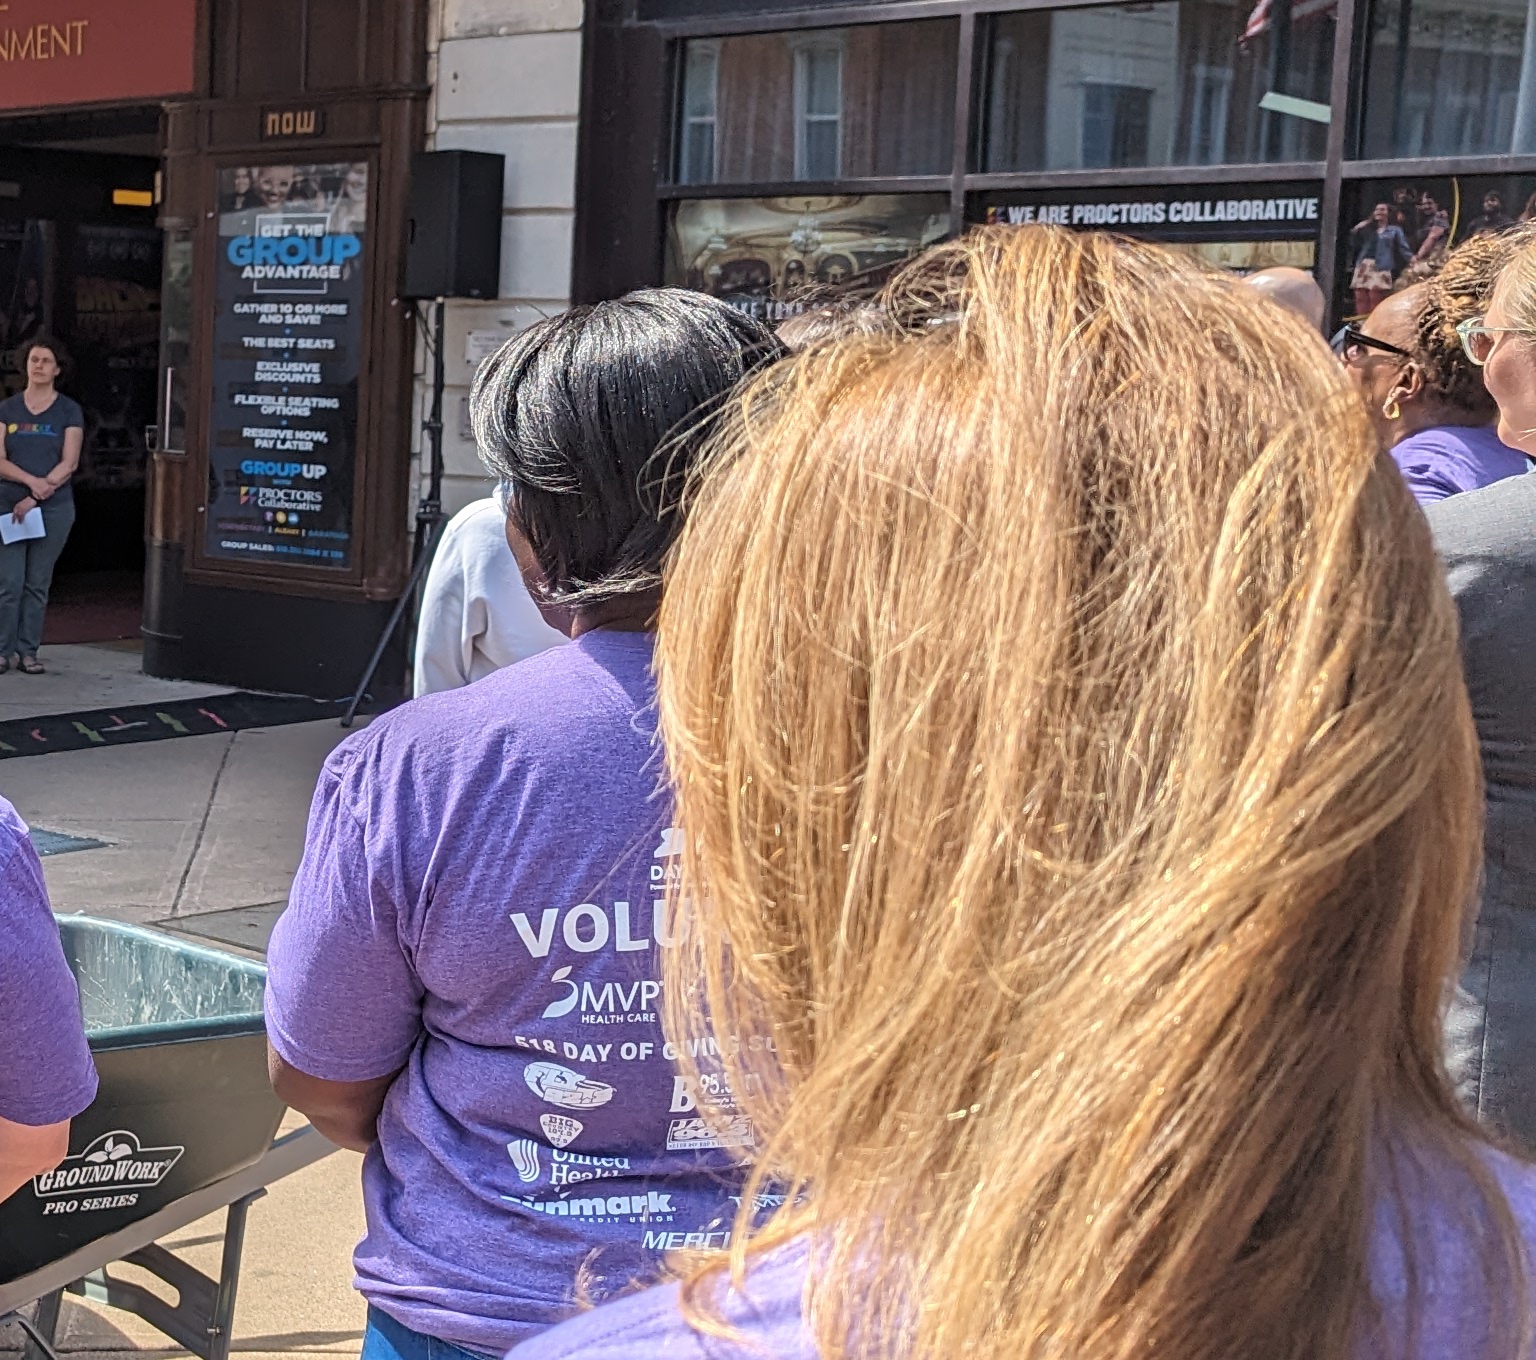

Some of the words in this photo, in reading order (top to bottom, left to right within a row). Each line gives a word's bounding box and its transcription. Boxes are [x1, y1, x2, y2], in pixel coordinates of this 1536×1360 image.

[1008, 206, 1034, 224] WE
[1037, 205, 1068, 223] ARE
[1074, 203, 1165, 225] PROCTORS
[1169, 198, 1317, 223] COLLABORATIVE
[261, 225, 291, 237] GET
[295, 224, 323, 237] THE
[227, 234, 360, 266] GROUP
[241, 265, 341, 280] ADVANTAGE
[233, 303, 278, 314] GATHER
[280, 303, 293, 314] 10
[295, 303, 313, 314] OR
[315, 303, 347, 315] MORE
[259, 314, 283, 324] AND
[242, 337, 267, 348] THE
[268, 338, 296, 349] BEST
[298, 338, 335, 350] SEATS
[256, 361, 321, 373] EXCLUSIVE
[254, 372, 321, 384] DISCOUNTS
[234, 394, 286, 407] FLEXIBLE
[287, 396, 339, 408] SEATING
[260, 405, 311, 417] OPTIONS
[242, 428, 294, 440] RESERVE
[254, 439, 275, 450] PAY
[276, 440, 313, 451] LATER
[258, 488, 322, 502] PROCTORS
[257, 498, 322, 512] Collaborative
[580, 980, 660, 1012] MVP
[581, 1013, 624, 1025] HEALTH
[627, 1013, 656, 1023] CARE
[515, 1036, 556, 1054] 518
[564, 1042, 611, 1063] DAY
[620, 1042, 653, 1060] OF
[42, 1200, 78, 1215] PRO
[80, 1193, 138, 1211] SERIES
